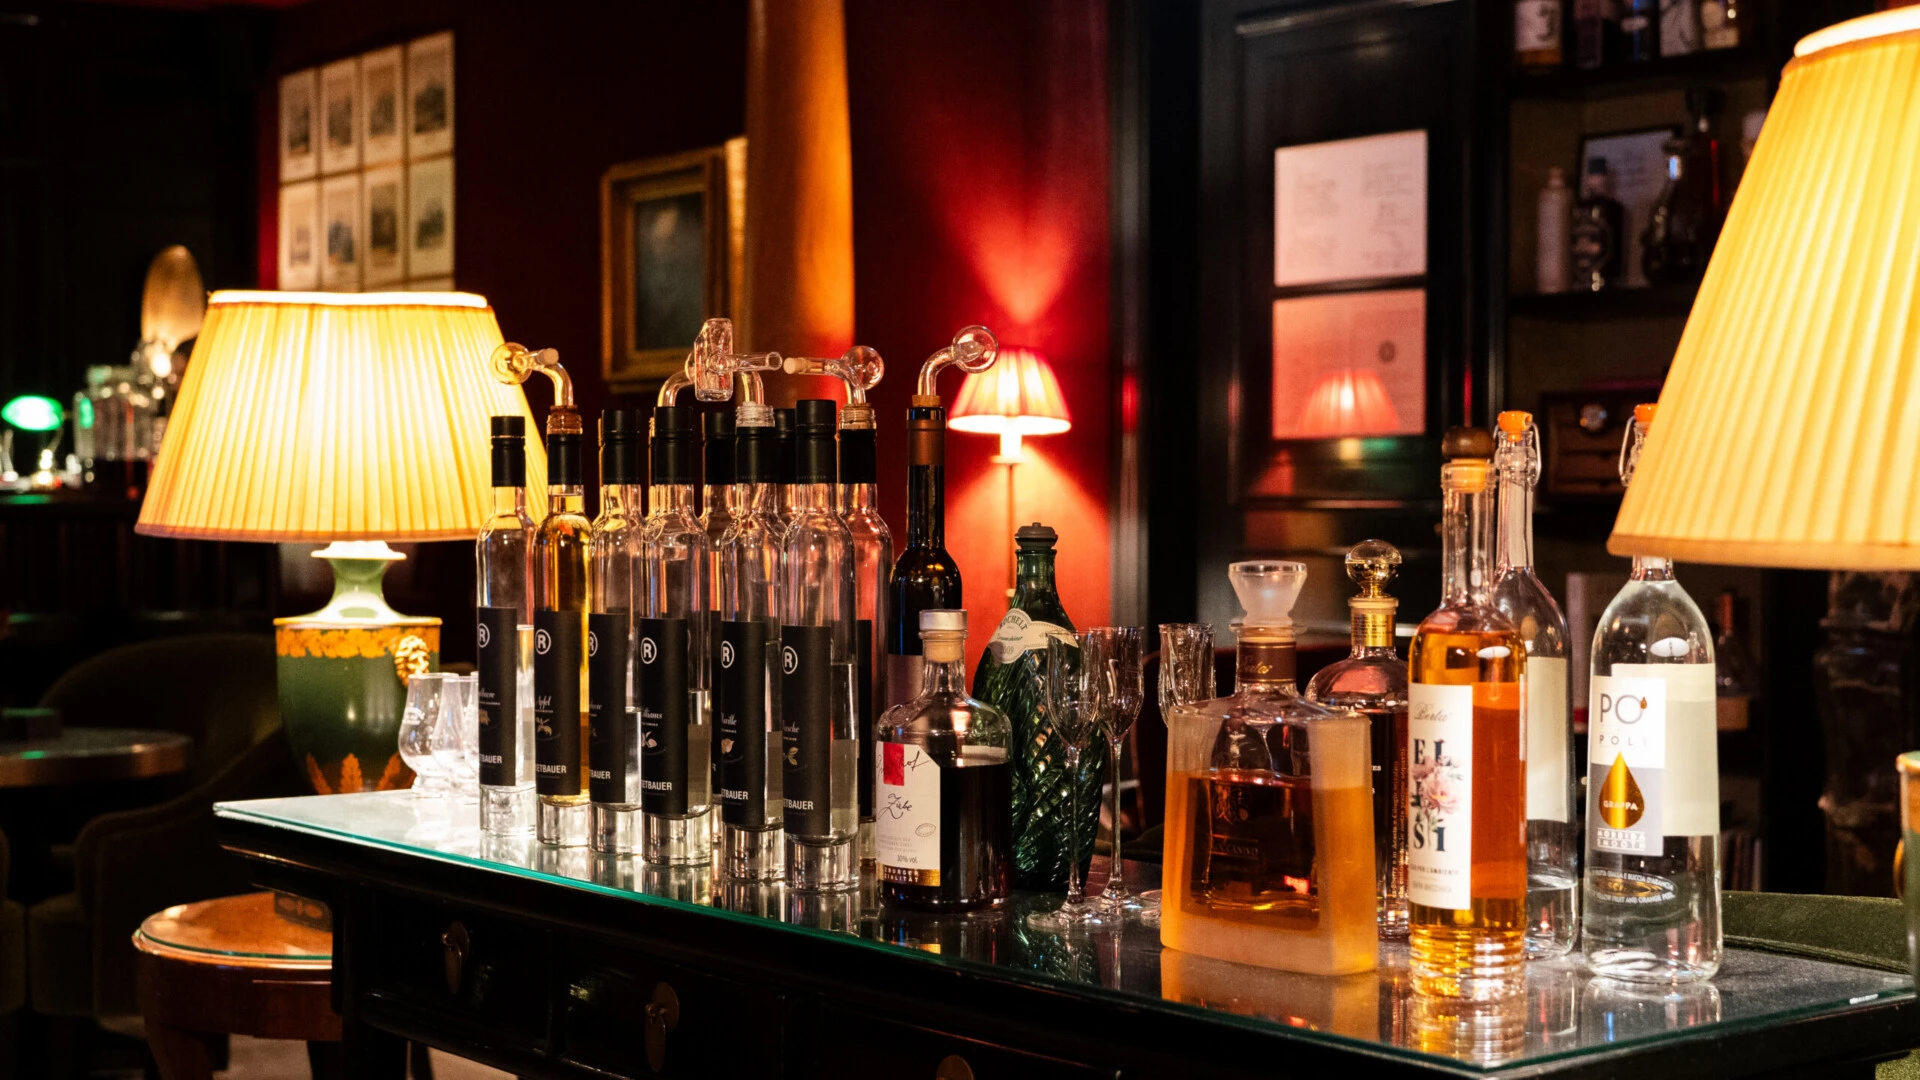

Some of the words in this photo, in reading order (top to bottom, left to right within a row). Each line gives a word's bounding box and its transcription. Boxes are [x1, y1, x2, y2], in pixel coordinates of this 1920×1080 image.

[1603, 800, 1639, 812] GRAPPA
[1597, 830, 1645, 841] MORBIDA
[1597, 838, 1645, 849] SMOOTH
